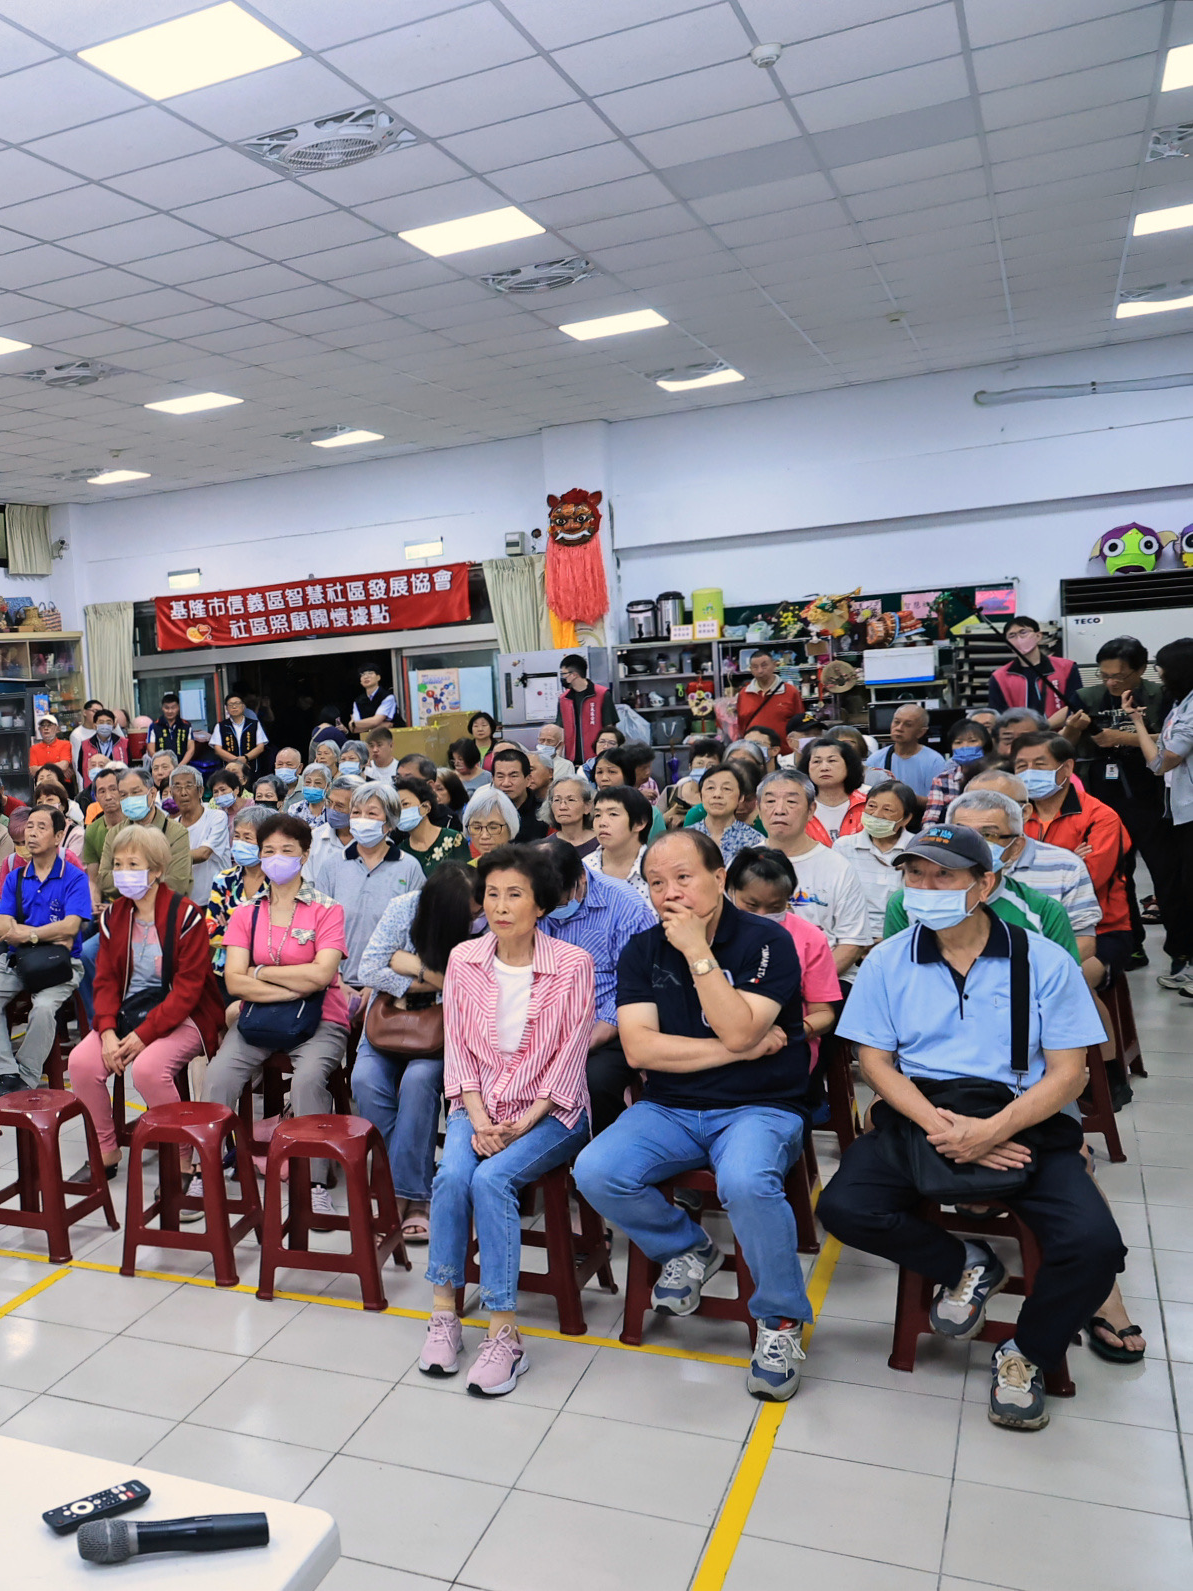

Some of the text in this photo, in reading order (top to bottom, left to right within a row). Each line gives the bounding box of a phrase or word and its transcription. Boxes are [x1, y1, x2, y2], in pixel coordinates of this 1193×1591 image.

[169, 569, 453, 620] 基隆市信義區智慧社區發展協會
[229, 603, 391, 639] 社區照顧關懷據點
[1074, 617, 1101, 625] TECO
